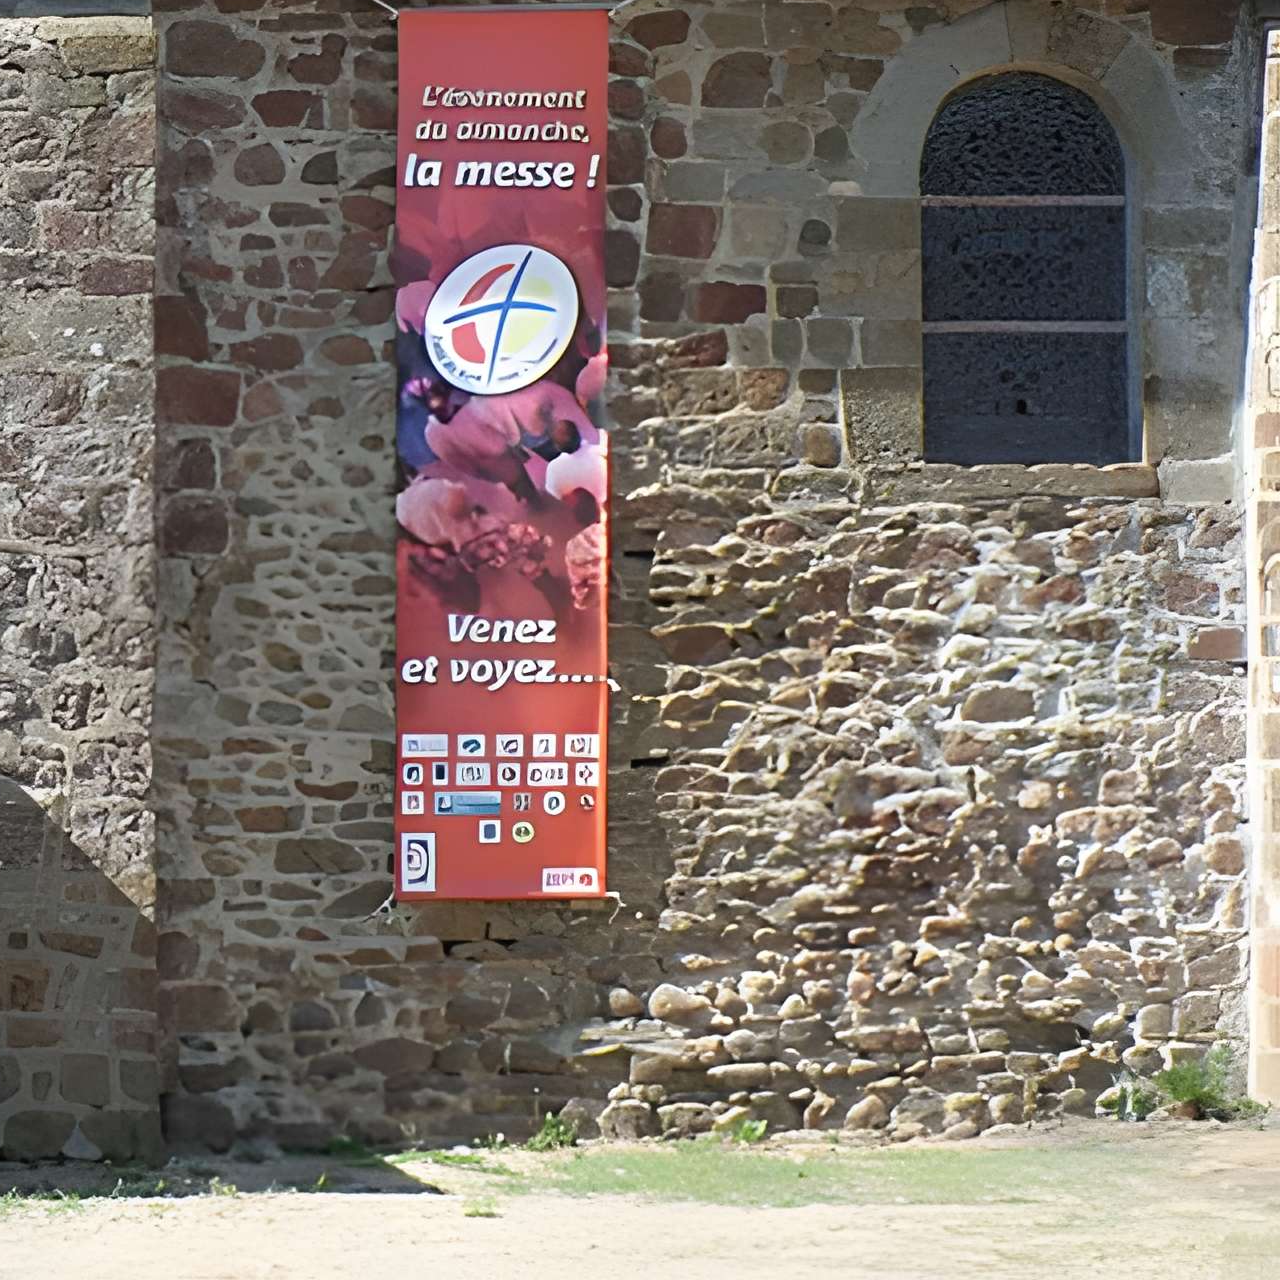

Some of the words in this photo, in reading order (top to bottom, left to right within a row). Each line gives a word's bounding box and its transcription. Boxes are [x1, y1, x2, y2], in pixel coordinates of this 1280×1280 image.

[415, 120, 447, 140] du
[404, 153, 442, 187] la
[455, 160, 575, 188] messe
[586, 154, 600, 188] !
[448, 613, 556, 643] Venez
[401, 655, 439, 683] et
